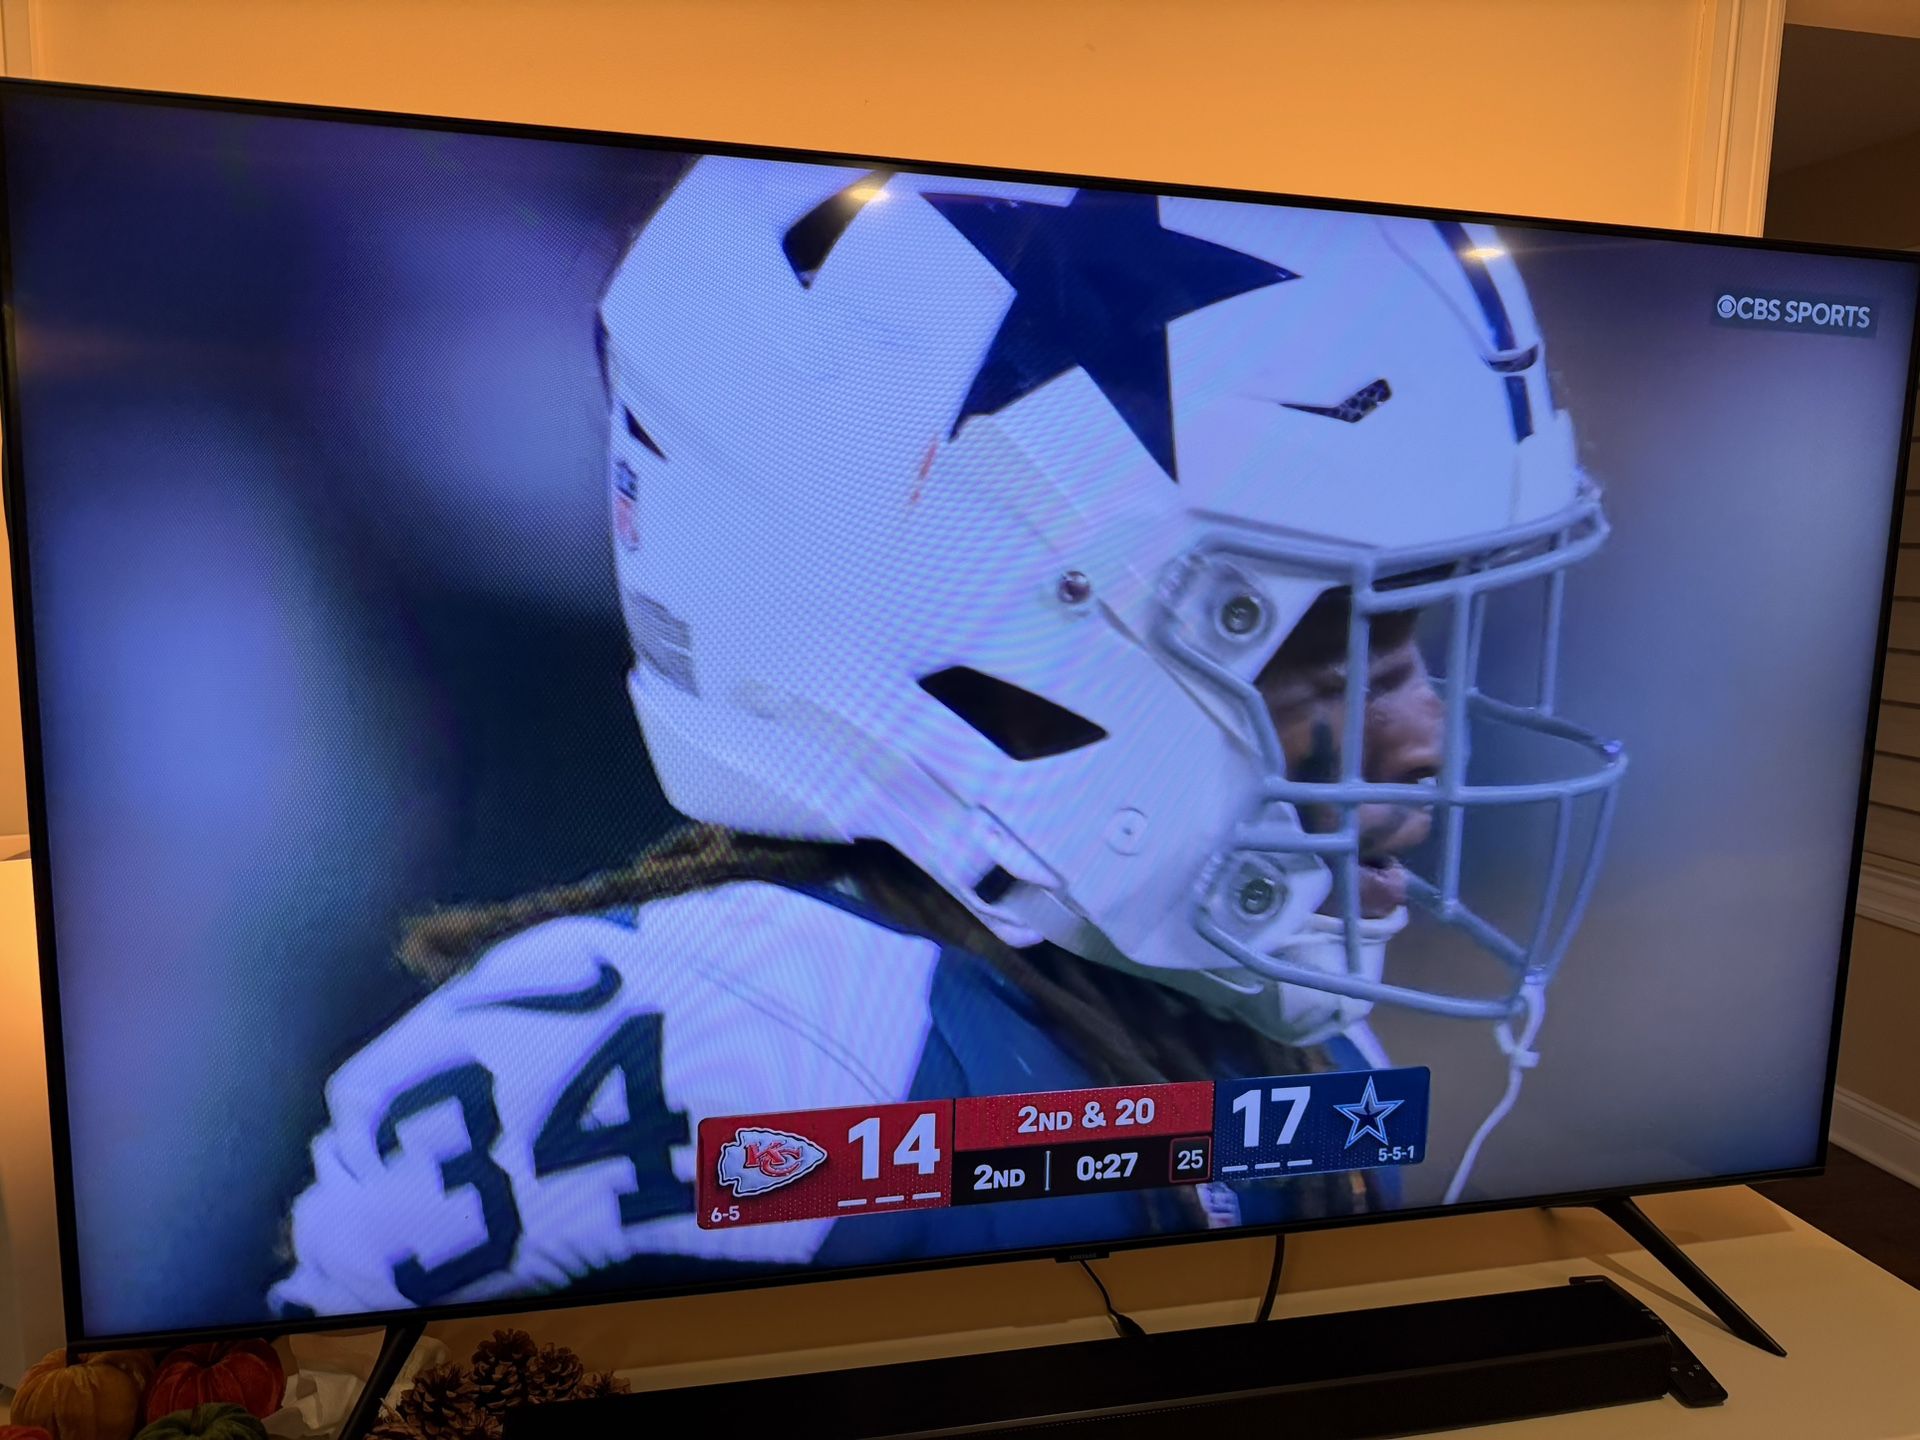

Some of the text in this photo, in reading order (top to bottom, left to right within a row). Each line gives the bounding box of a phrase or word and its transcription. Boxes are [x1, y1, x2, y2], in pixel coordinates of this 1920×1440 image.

[1737, 296, 1871, 329] CBS SPORTS
[1017, 1097, 1156, 1135] 2ND & 20
[1232, 1085, 1311, 1149] 17
[375, 1011, 697, 1307] 34
[743, 1140, 802, 1178] KC
[847, 1112, 941, 1182] 14
[1177, 1149, 1204, 1171] 25
[1377, 1145, 1415, 1163] 5-5-1
[973, 1163, 1026, 1191] 2ND
[1076, 1152, 1139, 1182] 0:27
[710, 1205, 741, 1223] 6-5
